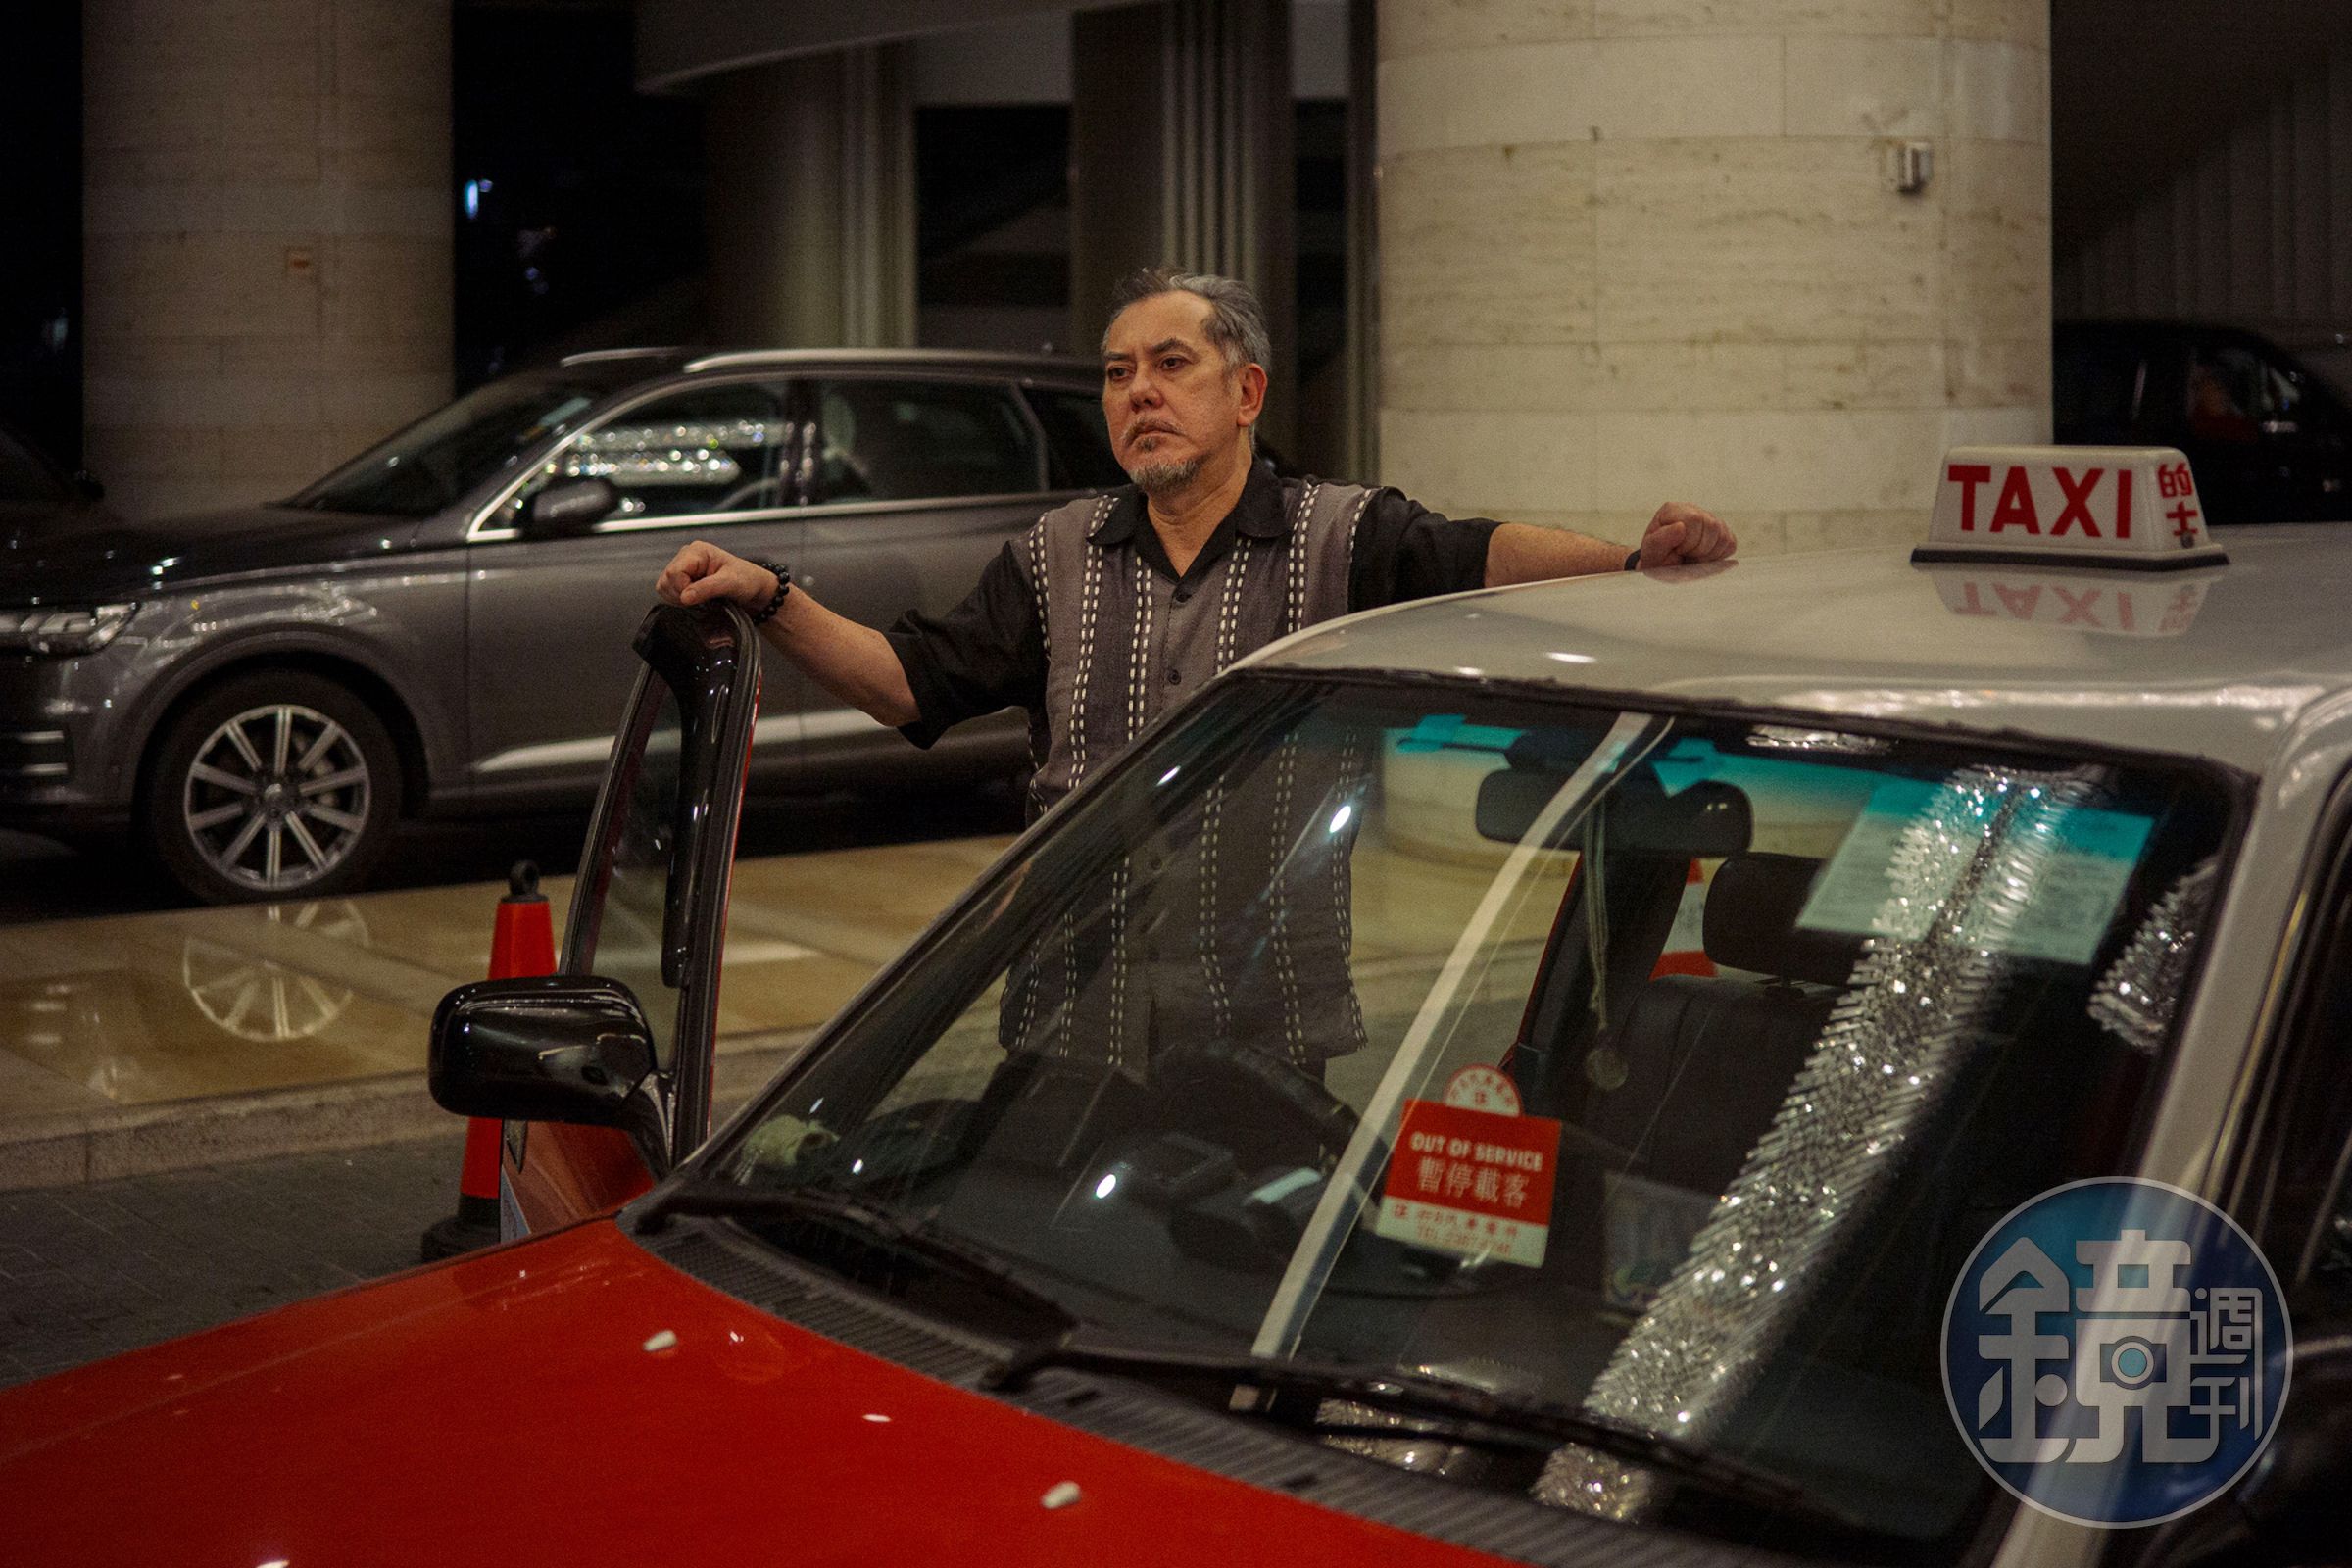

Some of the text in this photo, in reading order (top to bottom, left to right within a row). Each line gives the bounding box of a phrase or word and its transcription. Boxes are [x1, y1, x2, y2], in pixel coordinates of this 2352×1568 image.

[1947, 464, 2133, 539] TAXI
[2157, 462, 2199, 537] 的士
[1411, 1132, 1544, 1172] OUT OF SERVICE
[1419, 1157, 1529, 1207] 暫停載客
